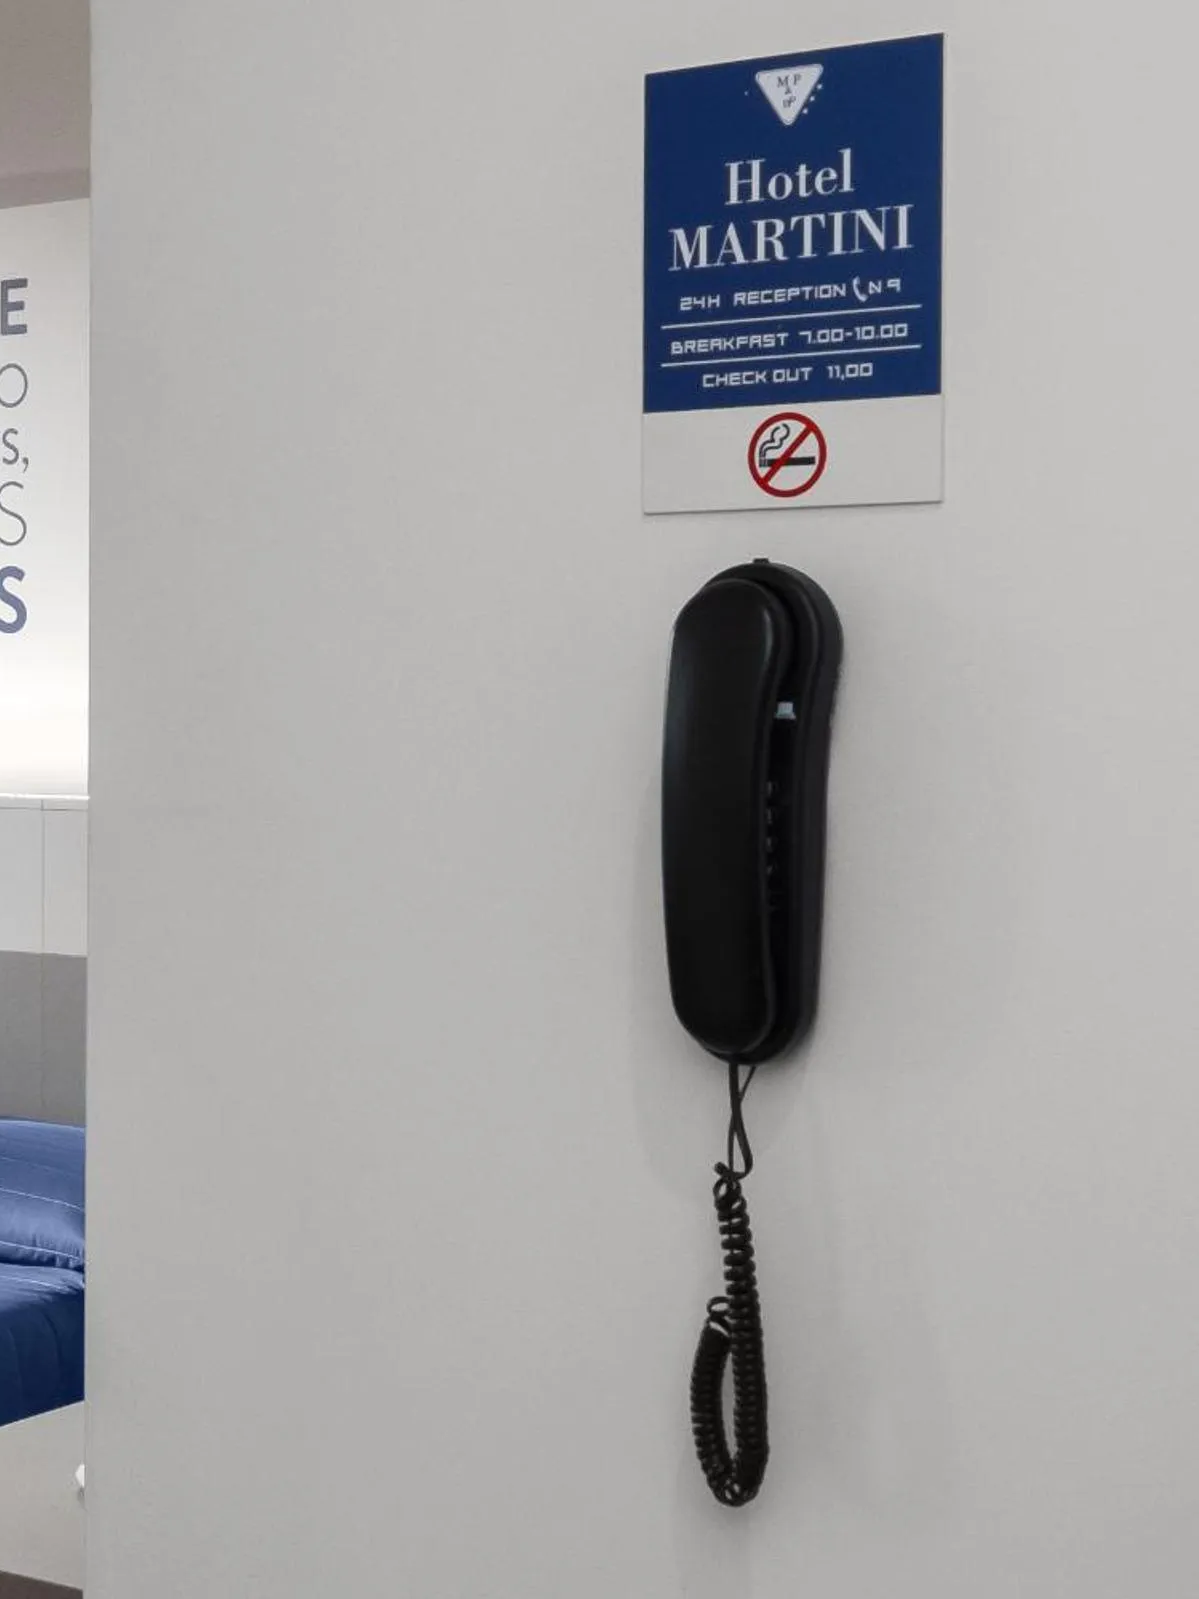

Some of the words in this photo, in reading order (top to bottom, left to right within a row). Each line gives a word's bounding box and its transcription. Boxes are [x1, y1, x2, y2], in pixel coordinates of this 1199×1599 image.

[724, 148, 855, 206] Hotel
[668, 204, 915, 271] MARTINI
[680, 294, 720, 311] 24H
[733, 283, 846, 306] RECEPTION
[886, 278, 901, 292] 9
[671, 332, 789, 355] BREAKFAST
[799, 323, 908, 345] 7.00-10.00
[702, 373, 767, 388] CHECK
[772, 367, 813, 383] OUT
